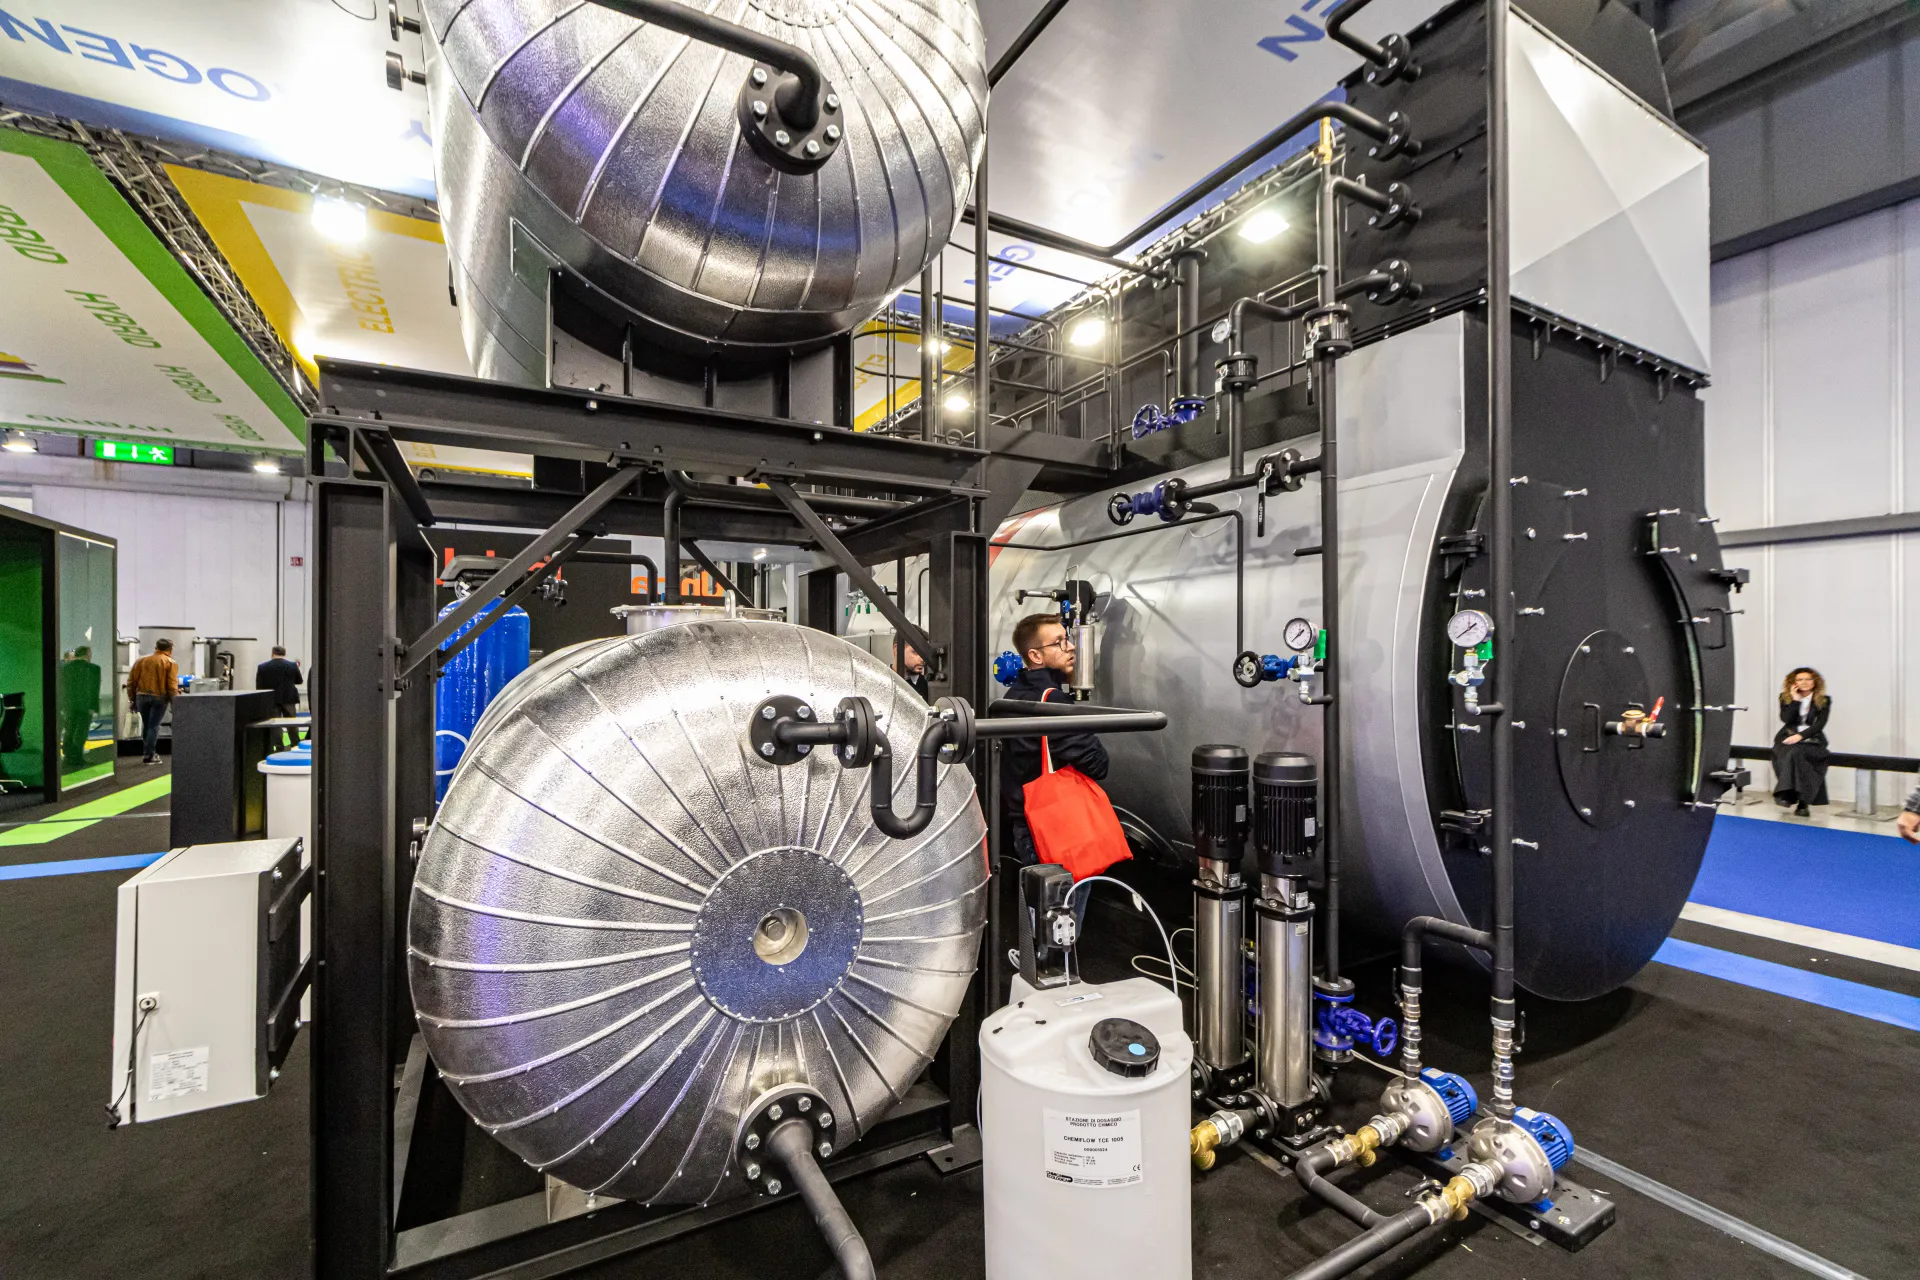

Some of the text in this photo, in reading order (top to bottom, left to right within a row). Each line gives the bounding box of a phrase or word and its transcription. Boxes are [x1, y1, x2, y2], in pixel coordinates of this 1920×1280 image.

[64, 289, 162, 349] HYBRID
[153, 364, 222, 404] HYBRID
[1063, 1135, 1096, 1143] CHEMIFLOW
